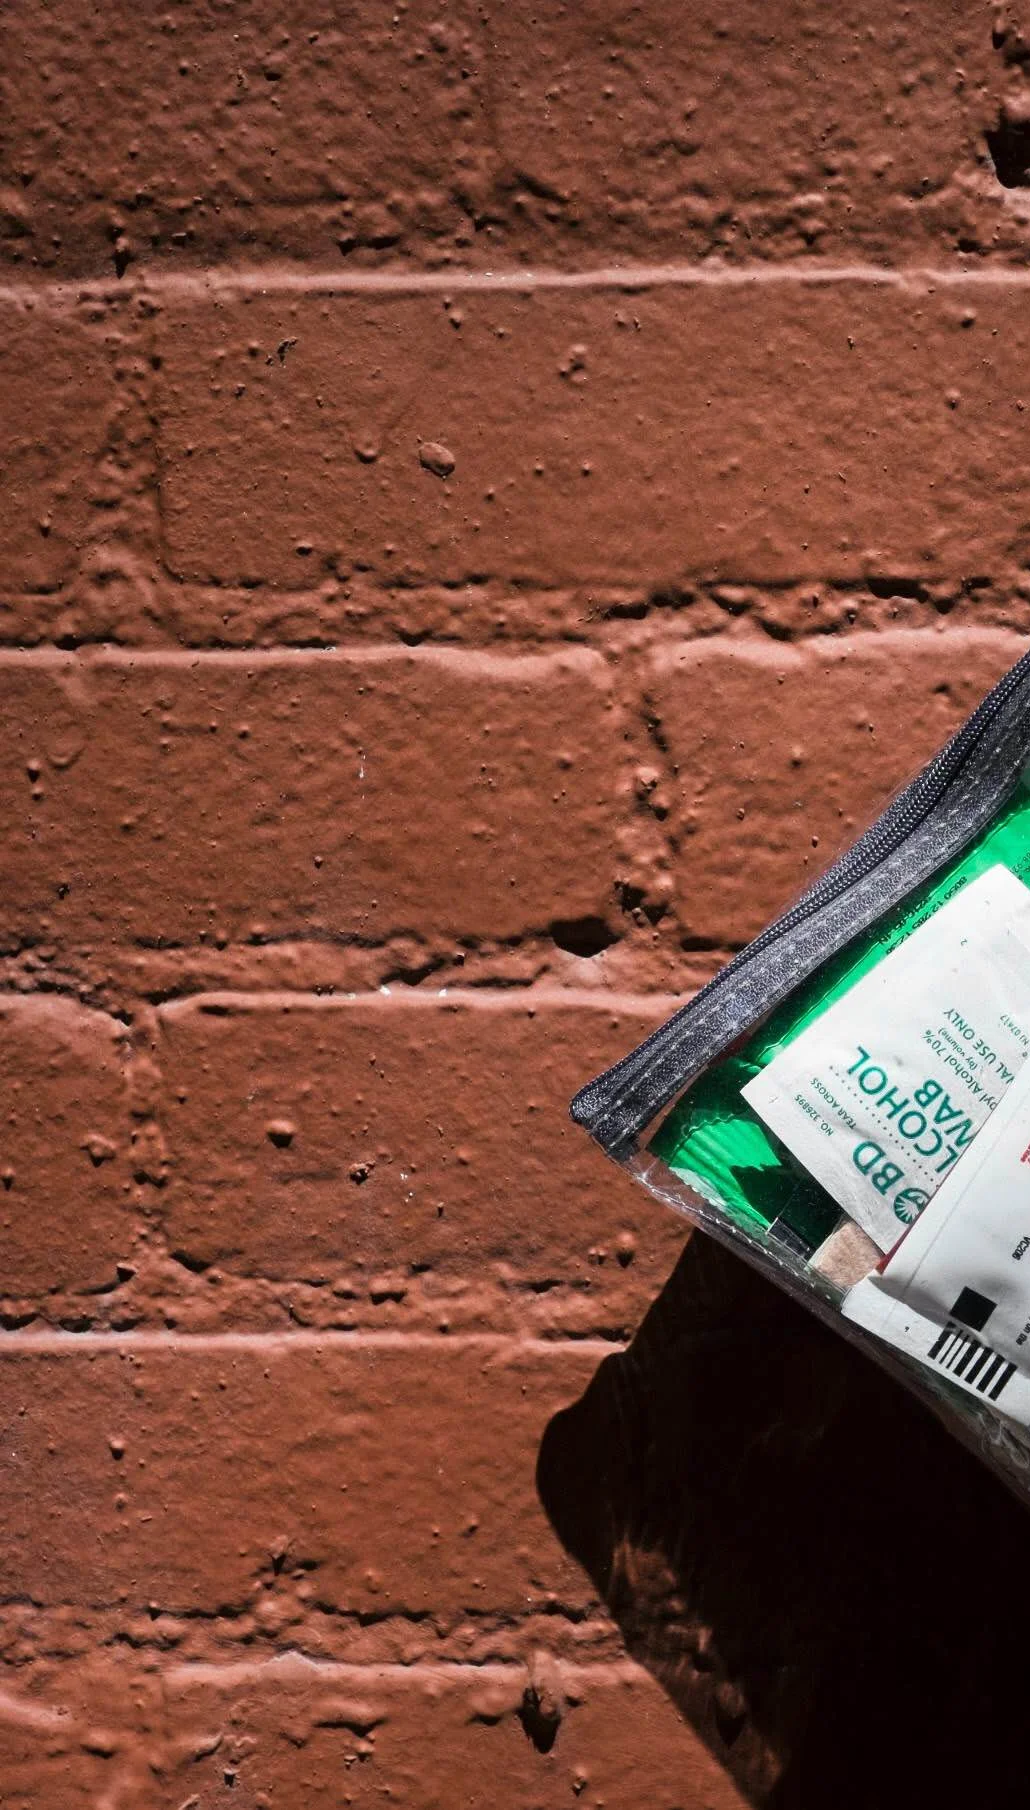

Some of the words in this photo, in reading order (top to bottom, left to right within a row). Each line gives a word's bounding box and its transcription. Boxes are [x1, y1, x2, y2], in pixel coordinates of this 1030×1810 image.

[942, 1005, 977, 1041] ONLY
[921, 1028, 947, 1055] 70%
[937, 1026, 967, 1058] volume)
[972, 1038, 997, 1064] USE
[943, 1053, 982, 1095] Alcohol
[963, 1055, 978, 1071] (by
[809, 1076, 840, 1110] ACROSS
[838, 1044, 960, 1175] LCOHOL
[817, 1119, 834, 1136] NO.
[836, 1107, 858, 1129] TEAR
[910, 1076, 980, 1150] WAB
[845, 1134, 905, 1196] BD
